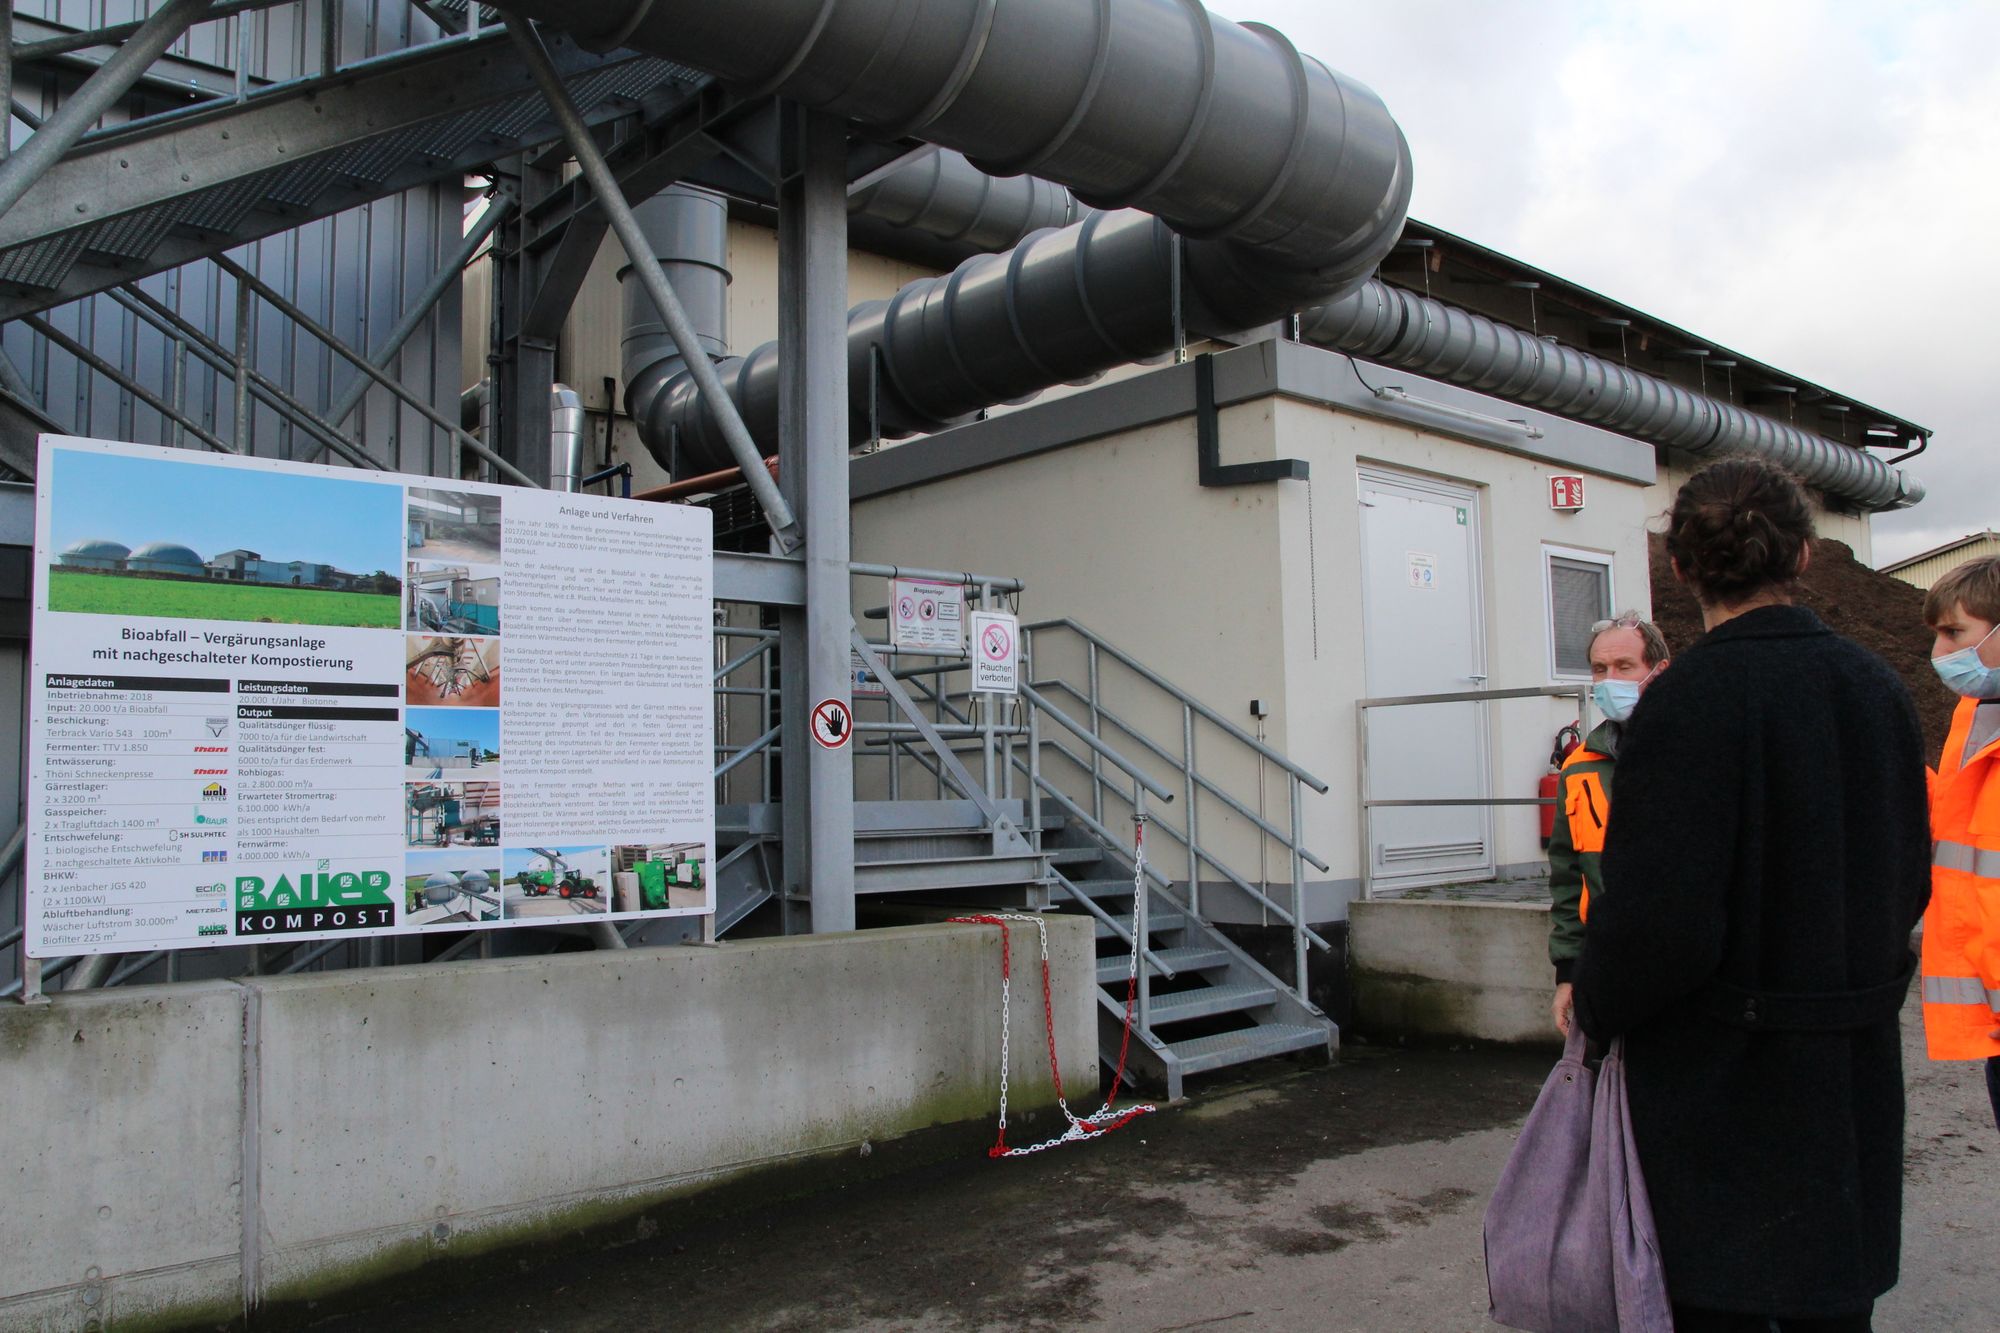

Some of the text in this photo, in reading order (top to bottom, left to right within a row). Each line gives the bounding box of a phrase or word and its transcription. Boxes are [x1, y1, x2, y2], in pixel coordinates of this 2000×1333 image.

[559, 506, 654, 524] Anlage und Verfahren
[121, 627, 187, 643] Bioabfall
[204, 631, 326, 650] Vergärungsanlage
[92, 648, 353, 671] mit nachgeschalteter Kompostierung
[980, 662, 1012, 672] Rauchen
[47, 677, 115, 688] Anlagedaten
[980, 674, 1012, 682] verboten
[239, 683, 308, 694] Leistungsdaten
[48, 691, 153, 701] Inbetriebnahme: 2018
[239, 696, 338, 705] 20.000 t/Jahr Biotonne
[47, 704, 168, 714] Input: 20.000 t/a Bioabfall
[238, 708, 273, 718] Output
[47, 717, 110, 726] Beschickung:
[239, 721, 336, 731] Qualitätsdünger flüssig:
[47, 729, 87, 737] Terbrack
[89, 729, 114, 738] Vario
[116, 730, 133, 738] 543
[239, 733, 259, 741] 7000
[261, 734, 279, 742] to/a
[309, 734, 367, 742] Landwirtschaft
[102, 744, 120, 752] TTV
[123, 744, 149, 752] 1.850
[238, 745, 305, 754] Qualitätsdünger
[46, 757, 116, 767] Entwässerung:
[238, 757, 259, 765] 6000
[261, 757, 279, 765] to/a
[280, 757, 292, 765] für
[310, 757, 353, 765] Erdenwerk
[45, 770, 154, 779] Thöni Schneckenpresse
[238, 769, 284, 778] Rohbiogas:
[45, 782, 108, 791] Gärrestlager:
[45, 795, 51, 803] 2
[61, 795, 85, 803] 3200
[285, 792, 337, 801] Stromertrag:
[45, 808, 107, 817] Gasspeicher:
[238, 804, 311, 813] 6.100.000 kWh/a
[45, 821, 51, 829] 2
[61, 820, 119, 830] Tragluftdach
[122, 820, 145, 828] 1400
[237, 817, 255, 825] Dies
[258, 816, 300, 825] entspricht
[301, 815, 319, 823] dem
[321, 815, 348, 823] Bedarf
[44, 832, 123, 842] Entschwefelung:
[237, 827, 320, 837] als 1000 Haushalten
[44, 843, 183, 855] 1. biologische Entschwefelung
[237, 840, 288, 849] Fernwärme:
[237, 852, 279, 860] 4.000.000
[283, 851, 310, 859] kWh/a
[43, 855, 181, 868] 2. nachgeschaltete Aktivkohle
[43, 872, 78, 881] BHKW:
[43, 885, 50, 893] 2
[59, 884, 108, 893] Jenbacher
[110, 882, 127, 890] JGS
[128, 881, 147, 890] 420
[43, 897, 53, 907] (2
[63, 895, 106, 905] 1100kW)
[43, 907, 134, 920] Abluftbehandlung:
[241, 909, 389, 931] KOMPOST
[42, 922, 84, 932] Wäscher
[87, 920, 133, 929] Luftstrom
[42, 934, 81, 945] Biofilter
[83, 934, 101, 943] 225
